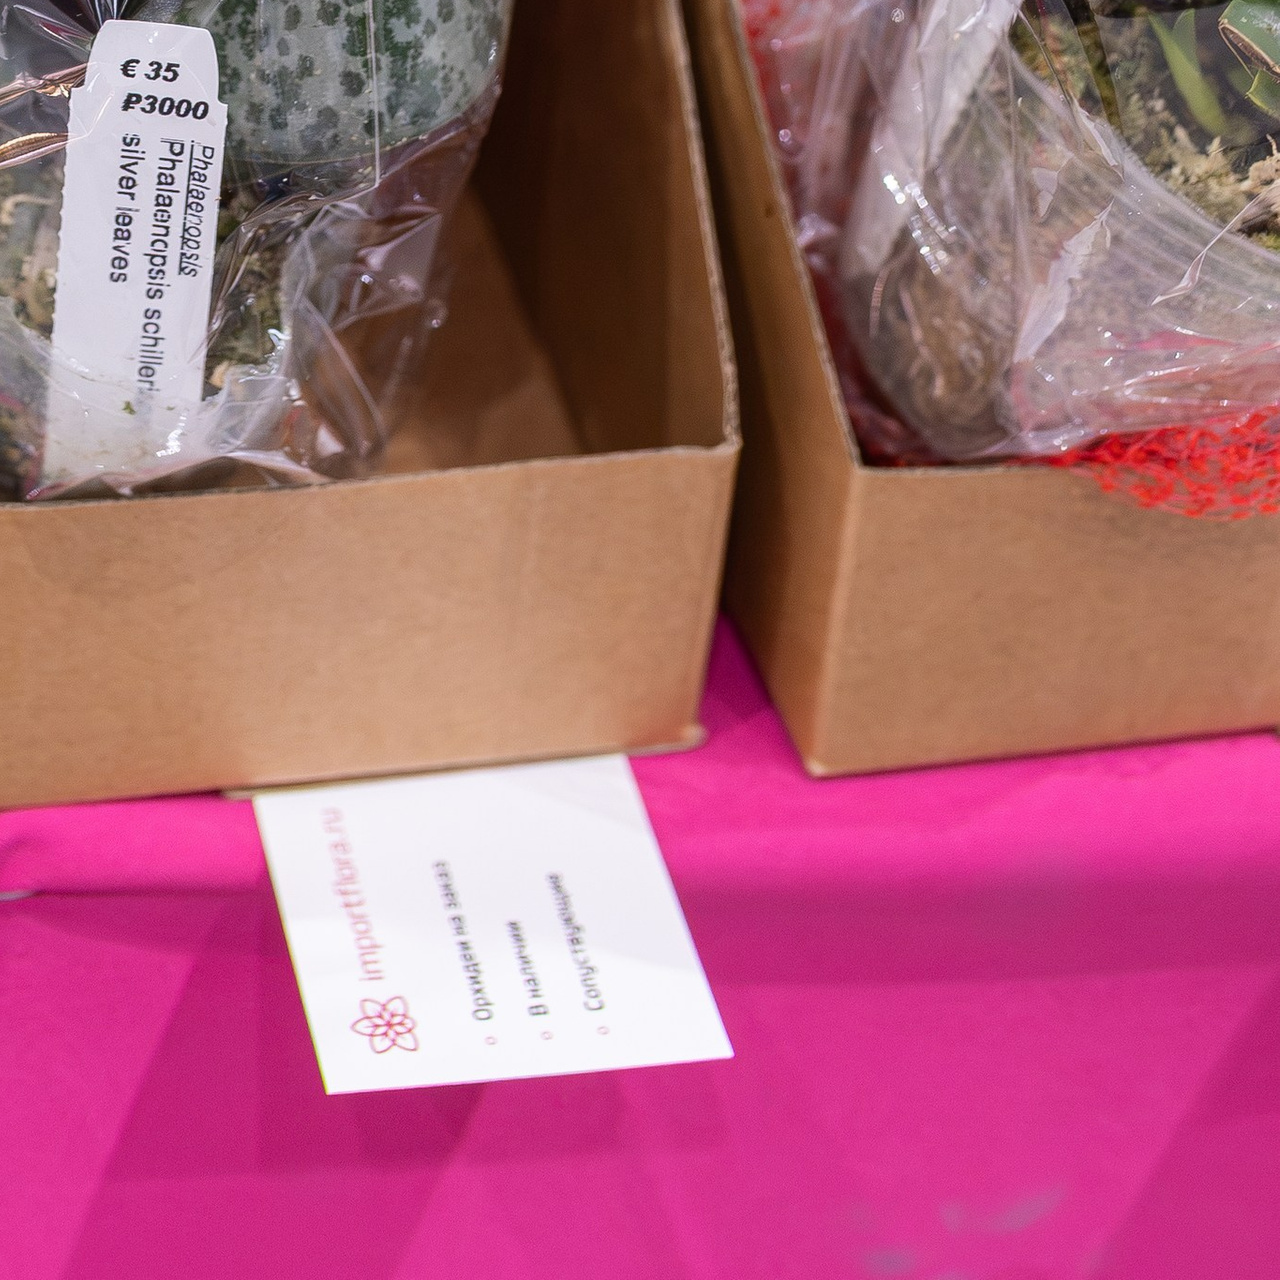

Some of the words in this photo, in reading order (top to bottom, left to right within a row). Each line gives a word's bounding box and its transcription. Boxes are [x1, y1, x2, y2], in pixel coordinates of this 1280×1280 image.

[120, 59, 141, 78] €
[144, 61, 180, 83] 35
[116, 132, 145, 207] silver
[110, 206, 140, 284] leaves
[143, 137, 186, 300] Phalaenopsis
[179, 142, 215, 279] Phalaenopsis
